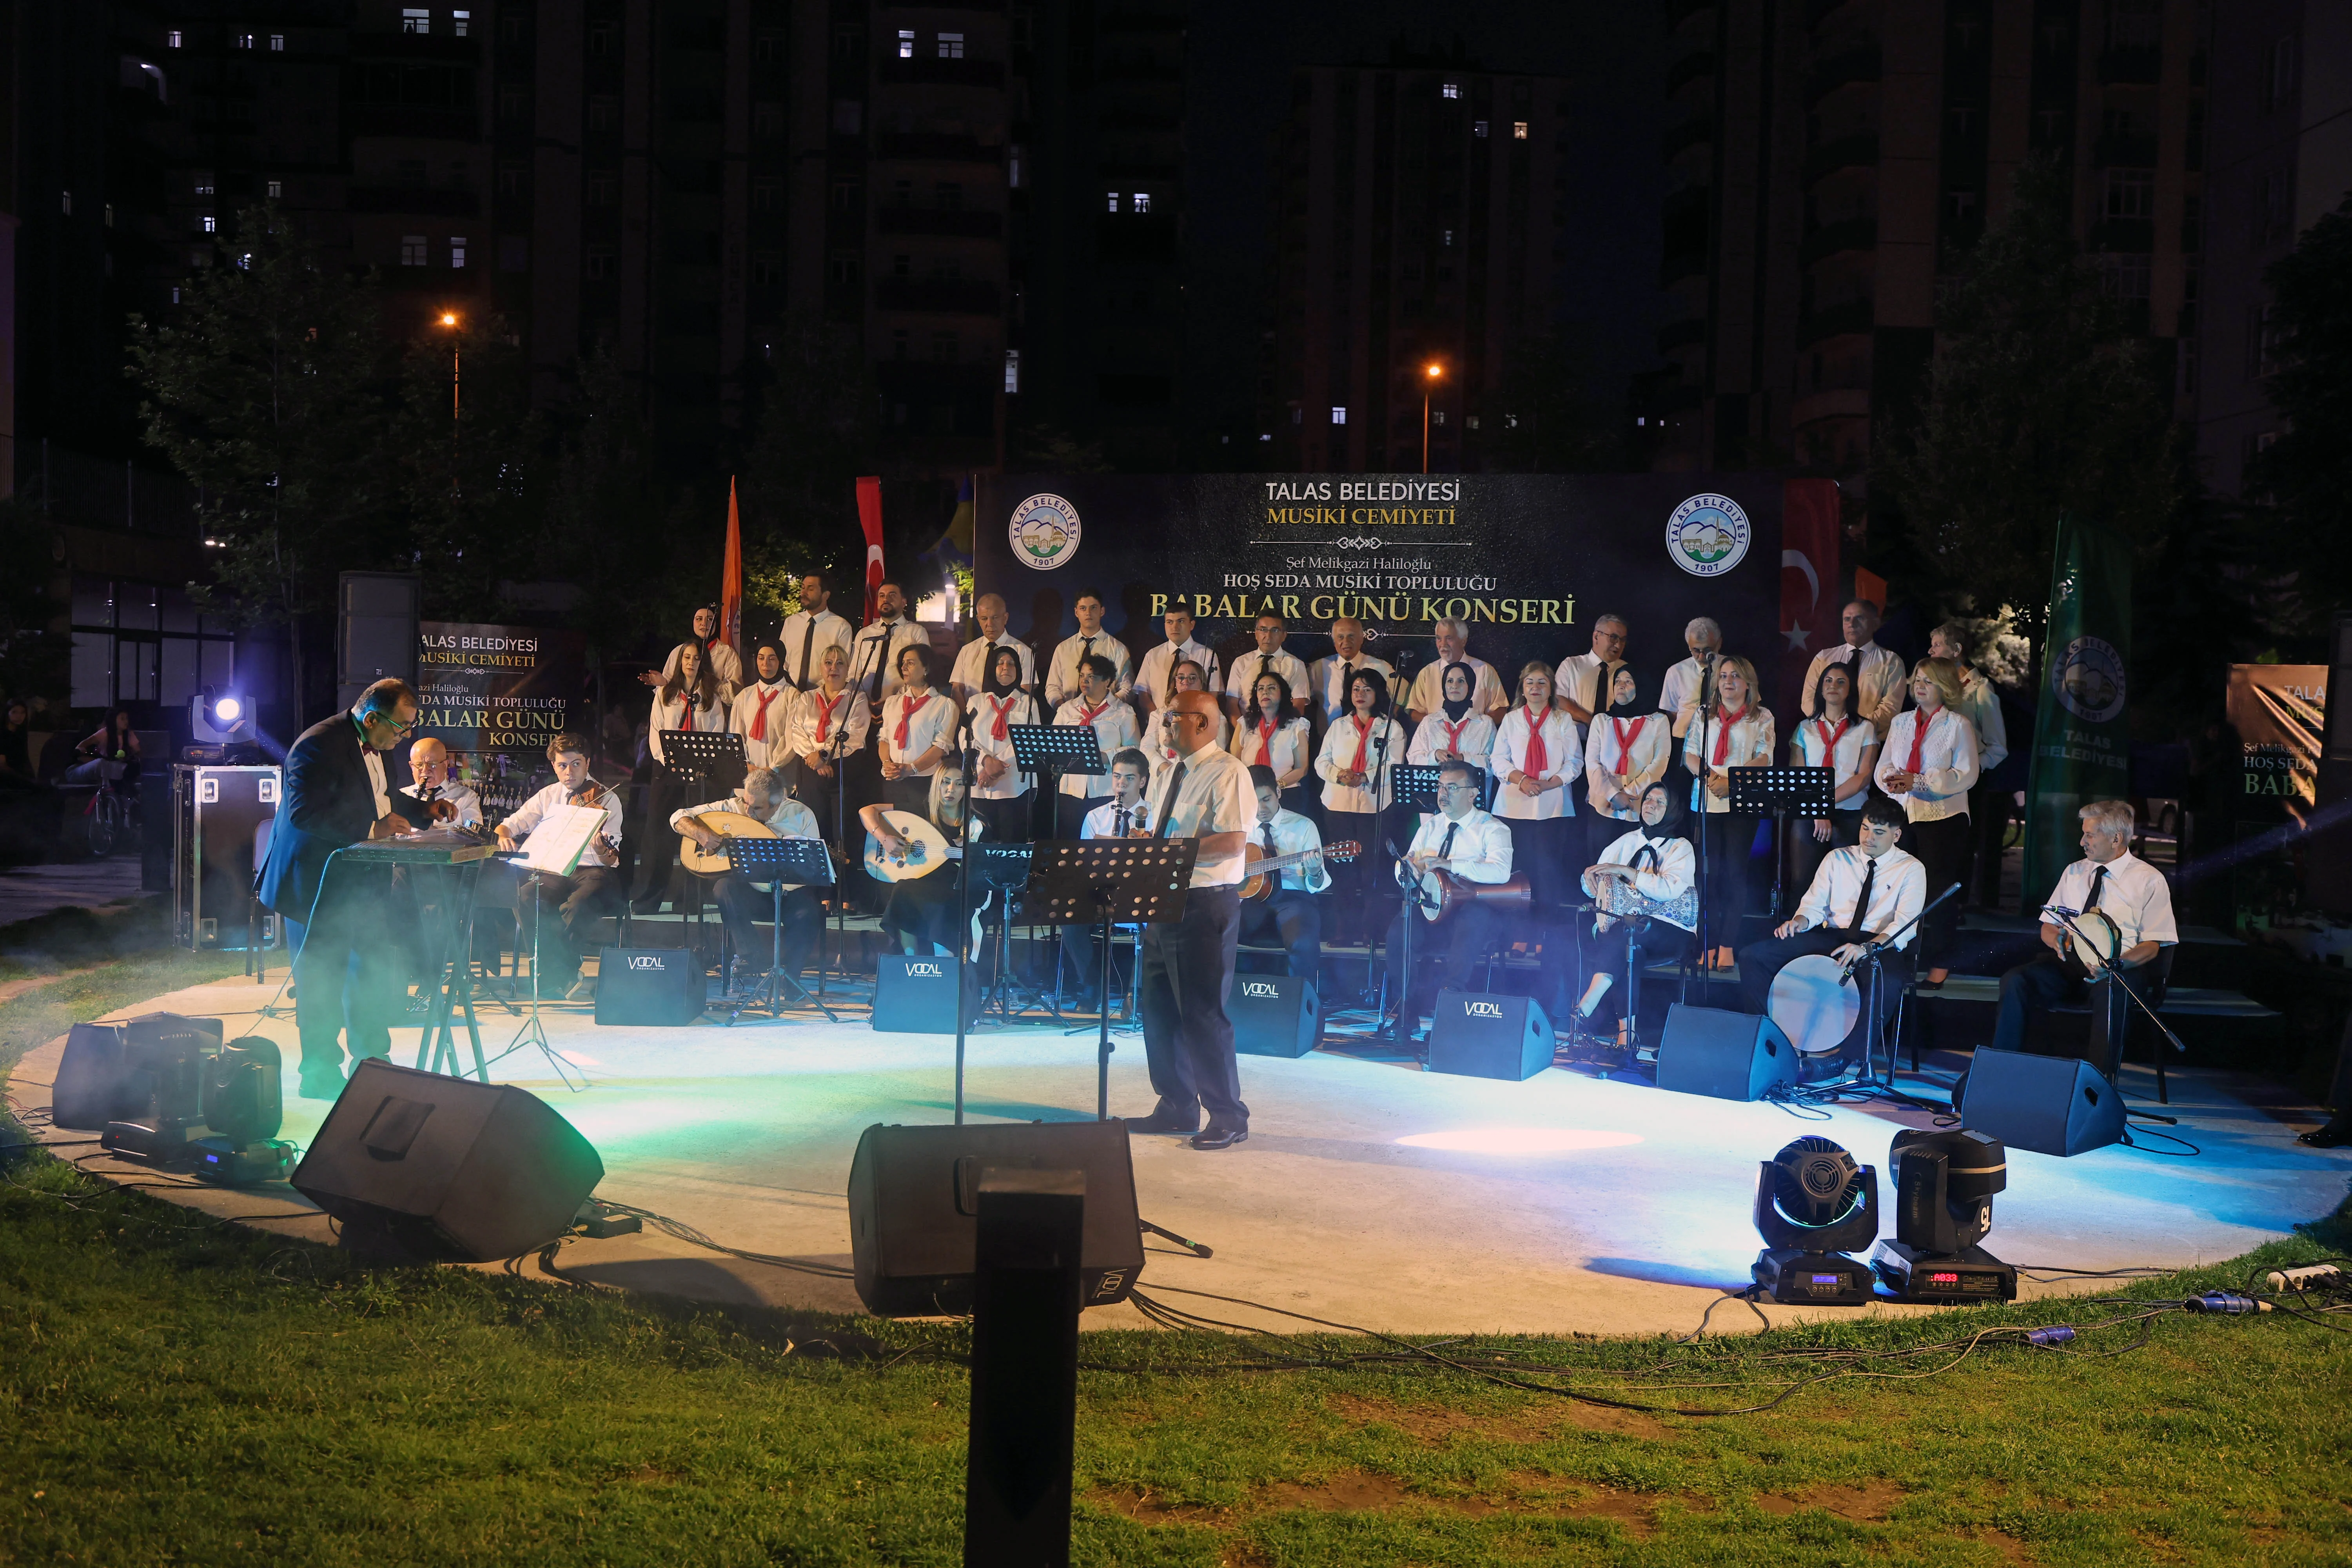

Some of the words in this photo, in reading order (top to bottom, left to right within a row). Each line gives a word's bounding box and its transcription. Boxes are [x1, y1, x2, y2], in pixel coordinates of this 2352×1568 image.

[1266, 481, 1331, 501] TALAS
[1340, 479, 1460, 501] BELEDİYESİ
[1266, 504, 1346, 524] MUSİKİ
[1352, 505, 1455, 525] CEMİYETİ
[1014, 506, 1029, 539] TALAS
[1671, 507, 1690, 544] TALAS
[1286, 557, 1306, 570] Şef
[1308, 557, 1369, 572] Melikgazi
[1372, 558, 1431, 573] Haliloğlu
[1695, 563, 1719, 572] 1907
[1223, 574, 1260, 591] HOŞ
[1265, 574, 1311, 588] SEDA
[1315, 572, 1381, 589] MUSİKİ
[1386, 574, 1497, 591] TOPLULUĞU
[1150, 593, 1302, 619] BBALAR
[1310, 590, 1412, 621] GÜNÜ
[1419, 593, 1576, 624] KONSERİ
[419, 635, 456, 648] ALAS
[461, 635, 537, 652] BELEDİYESİ
[470, 653, 535, 667] CEMİYETİ
[432, 684, 469, 695] Haliloğlu
[2284, 685, 2325, 700] TALA
[443, 694, 490, 706] MUSİKİ
[493, 697, 566, 709] TOPLULUĞU
[418, 710, 490, 728] BALAR
[496, 708, 566, 730] GÜNÜ
[2286, 706, 2325, 719] MUS
[489, 731, 563, 746] KONSE
[2064, 730, 2112, 750] TALAS
[2244, 742, 2258, 753] Şef
[2244, 757, 2274, 771] HOŞ
[2244, 773, 2316, 797] BABA
[627, 956, 665, 970] VOCAL
[905, 963, 942, 977] VOCAL
[1242, 982, 1279, 996] VOCAL
[1464, 1001, 1503, 1016] VOCAL
[1912, 1180, 1921, 1218] Skybeam
[1096, 1268, 1128, 1298] VOCAL
[1934, 1273, 1958, 1282] A033
